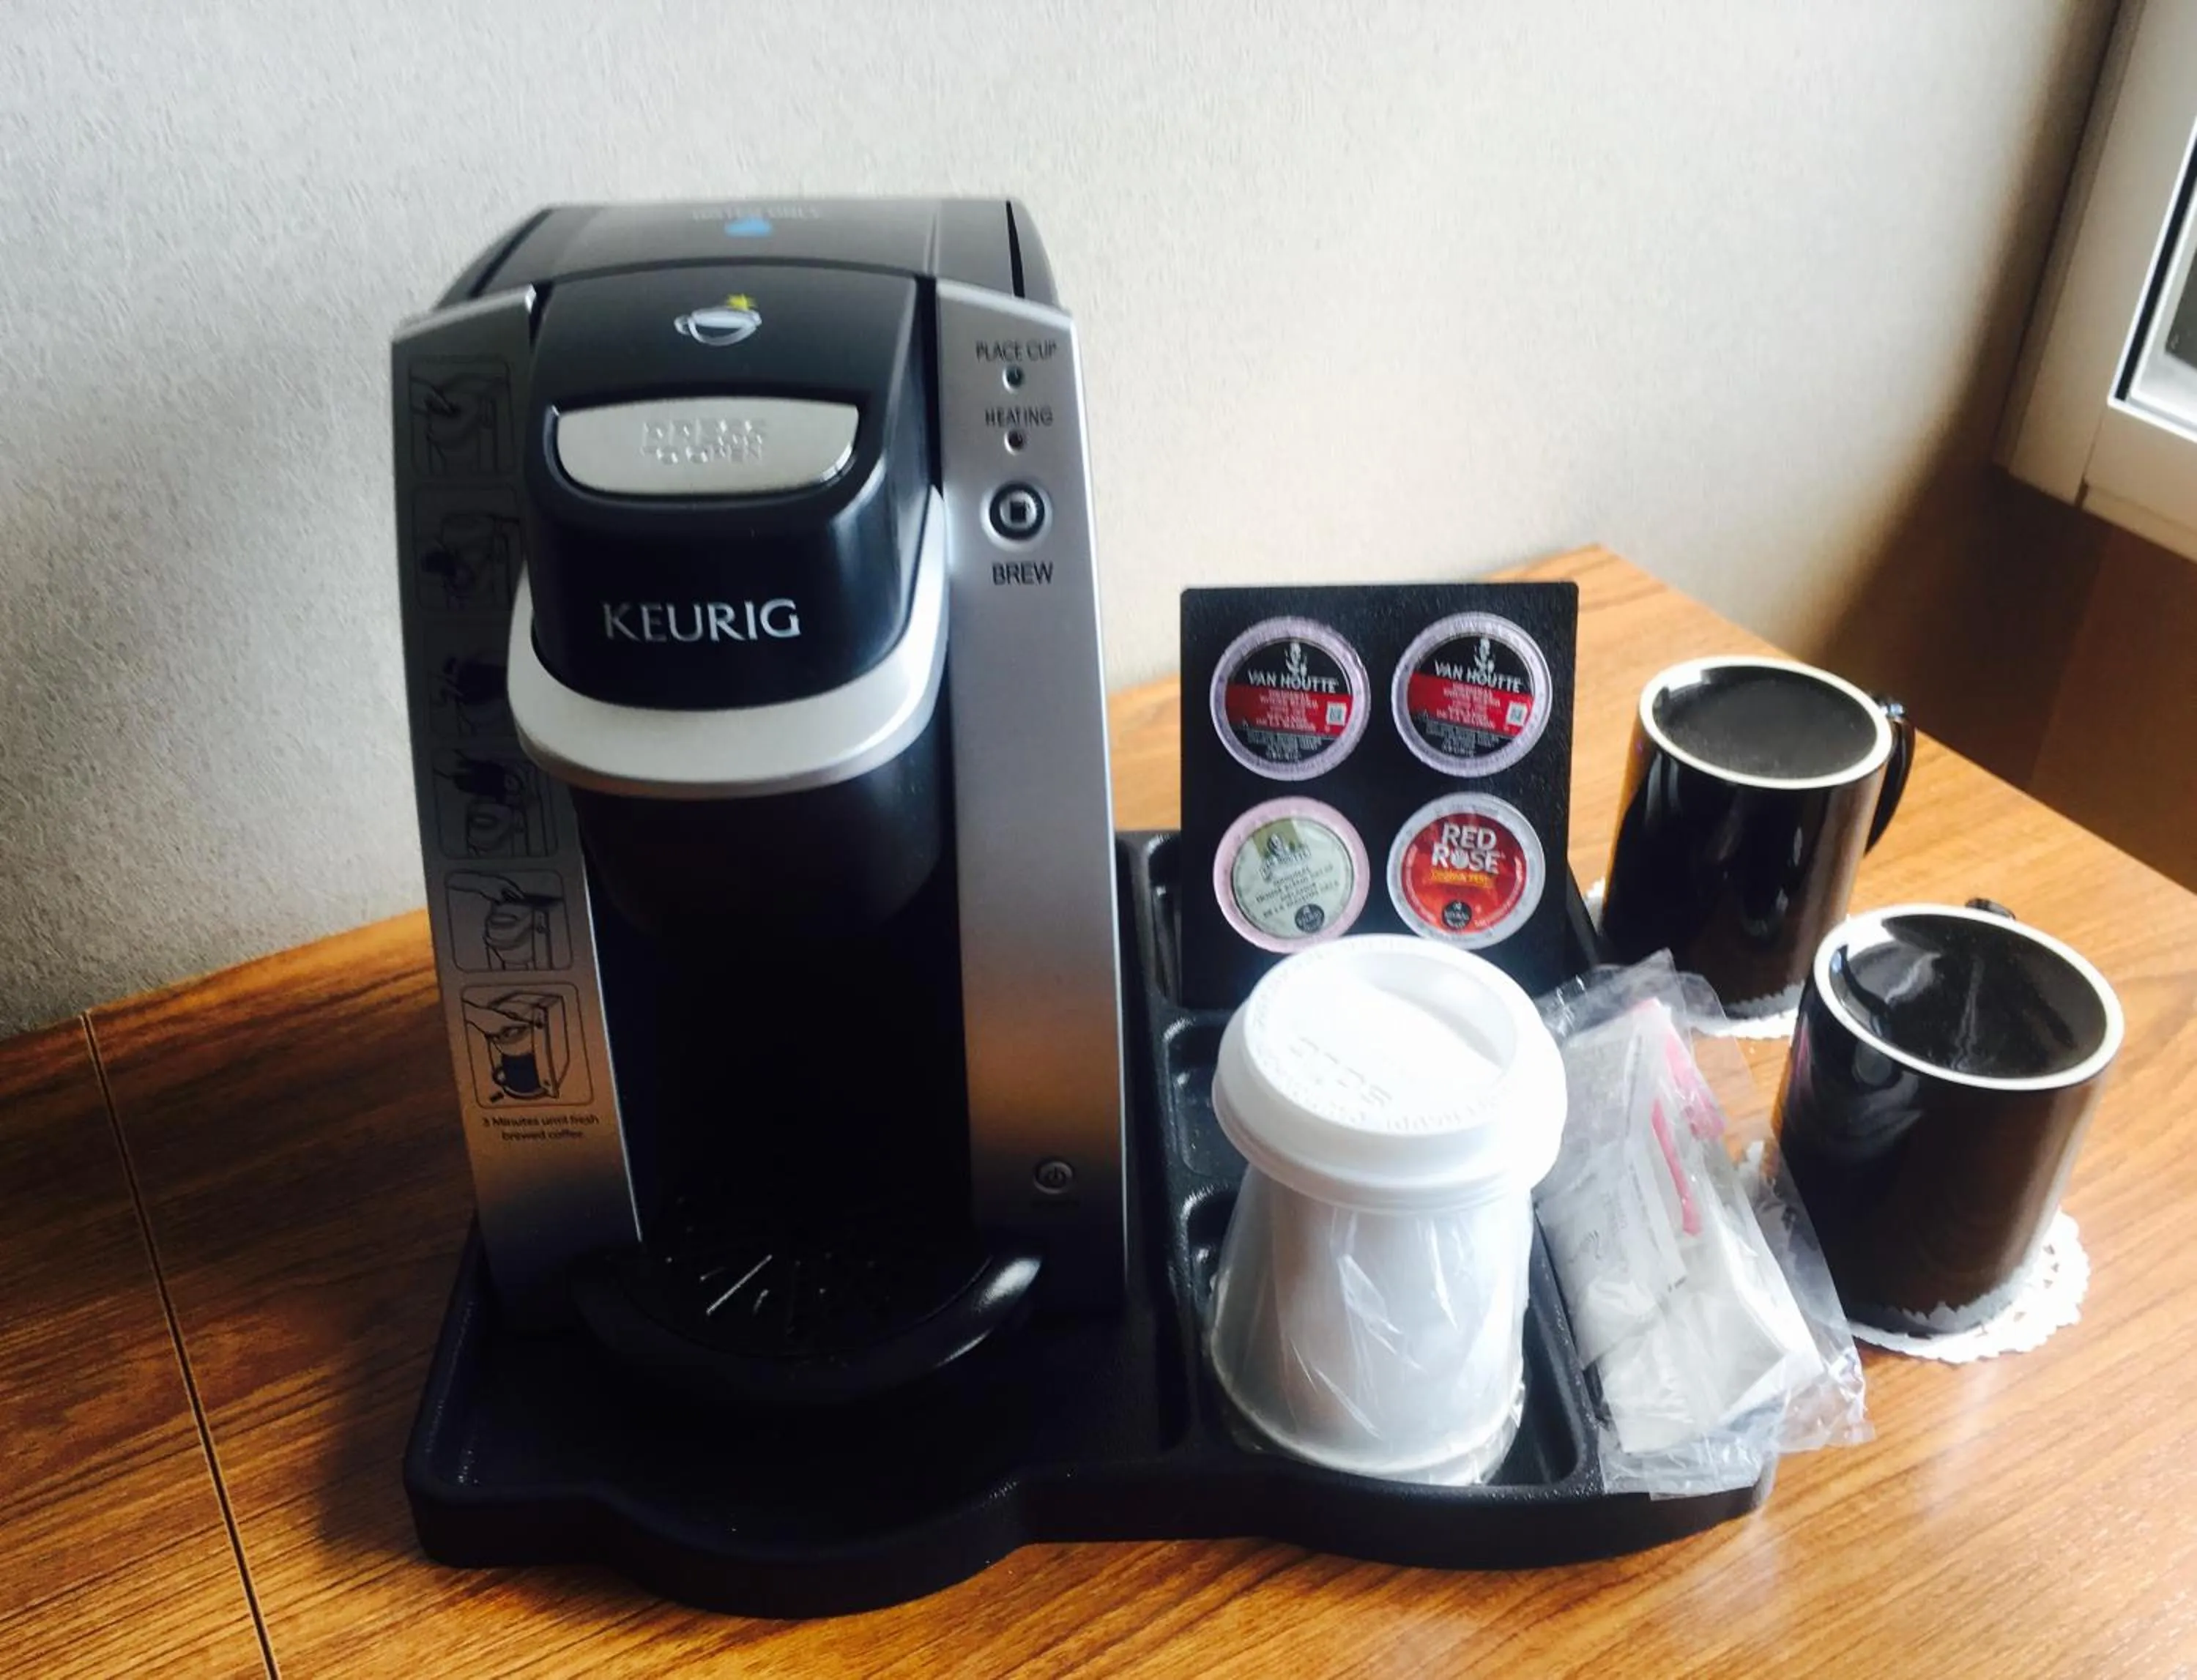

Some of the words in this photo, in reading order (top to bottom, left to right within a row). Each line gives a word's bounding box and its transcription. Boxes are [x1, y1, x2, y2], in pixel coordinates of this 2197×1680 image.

[975, 339, 1024, 362] PLACE
[1026, 338, 1057, 361] CUP
[984, 406, 1054, 427] HEATING
[991, 560, 1053, 585] BREW
[601, 598, 801, 643] KEURIG
[1248, 669, 1276, 688] VAN
[1280, 672, 1338, 694] HOUTTE
[1434, 660, 1463, 680] VAN
[1466, 667, 1522, 694] HOUTTE
[1442, 822, 1498, 851] RED
[1432, 842, 1501, 875] ROSE
[492, 1117, 540, 1127] Minutes
[570, 1115, 600, 1125] fresh
[502, 1129, 546, 1141] brewed
[549, 1128, 584, 1139] coffee
